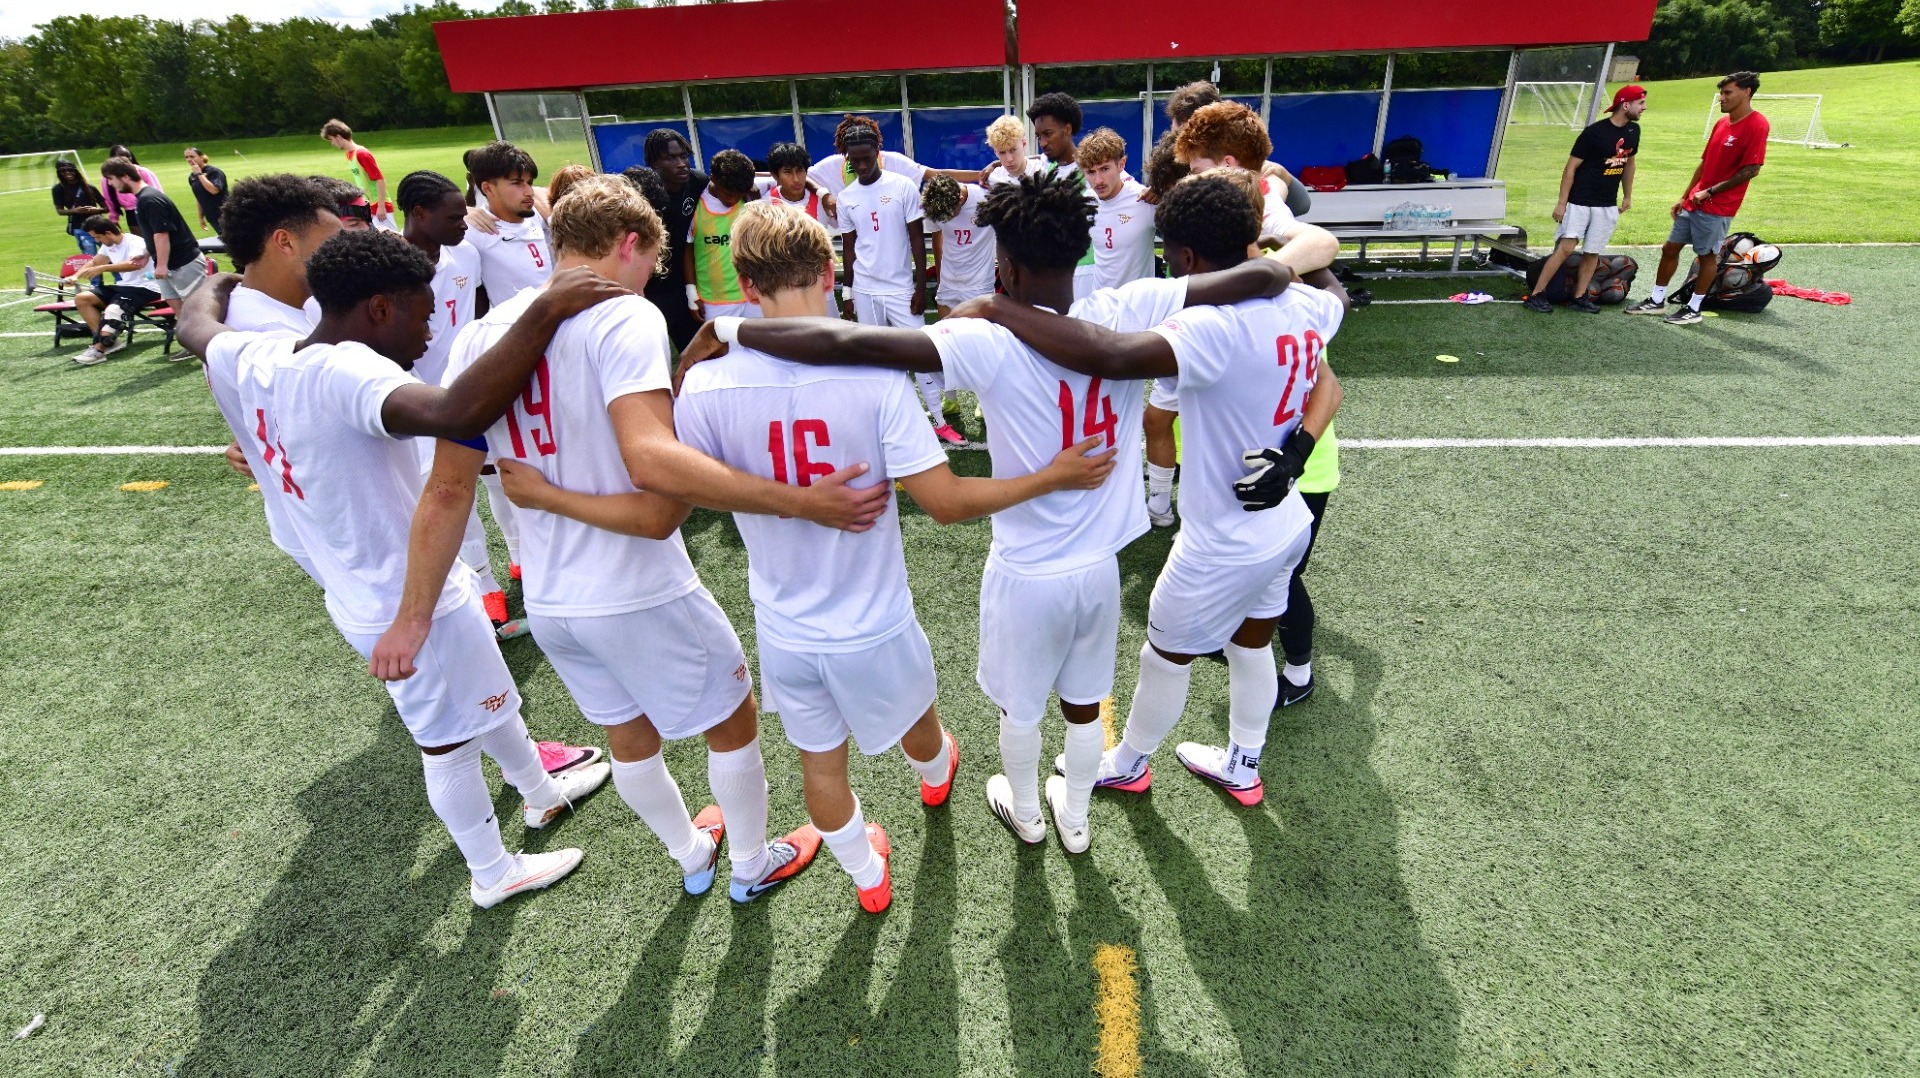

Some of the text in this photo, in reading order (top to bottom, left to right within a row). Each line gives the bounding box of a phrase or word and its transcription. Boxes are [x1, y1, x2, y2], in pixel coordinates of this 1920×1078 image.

[871, 211, 879, 231] 5
[704, 234, 730, 246] cap
[954, 229, 972, 245] 22
[1105, 228, 1112, 249] 3
[527, 243, 544, 268] 9
[445, 299, 456, 327] 7
[504, 355, 557, 458] 19
[1058, 375, 1118, 451] 14
[768, 419, 836, 518] 16
